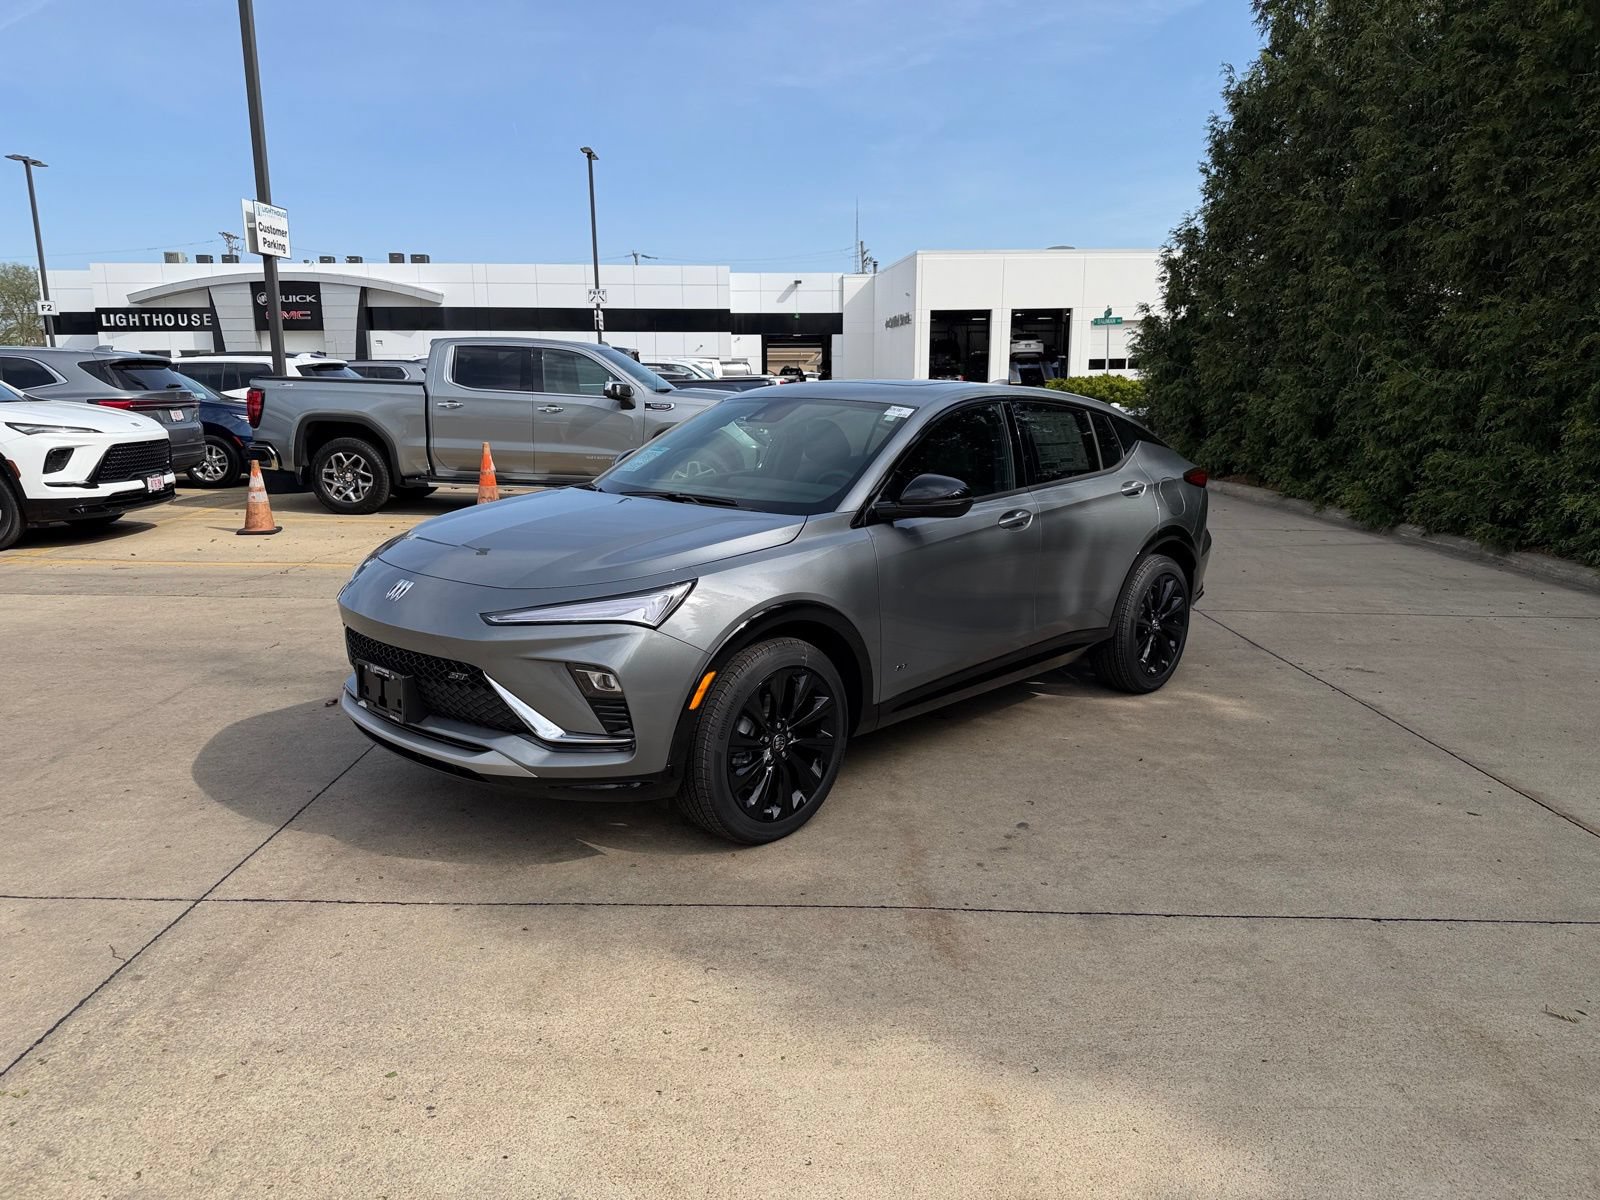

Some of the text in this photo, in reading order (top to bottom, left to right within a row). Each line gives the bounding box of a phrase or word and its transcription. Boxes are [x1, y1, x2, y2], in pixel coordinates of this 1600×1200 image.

[258, 221, 288, 237] Customer
[262, 236, 286, 254] Parking
[101, 313, 212, 327] LIGHTHOUSE
